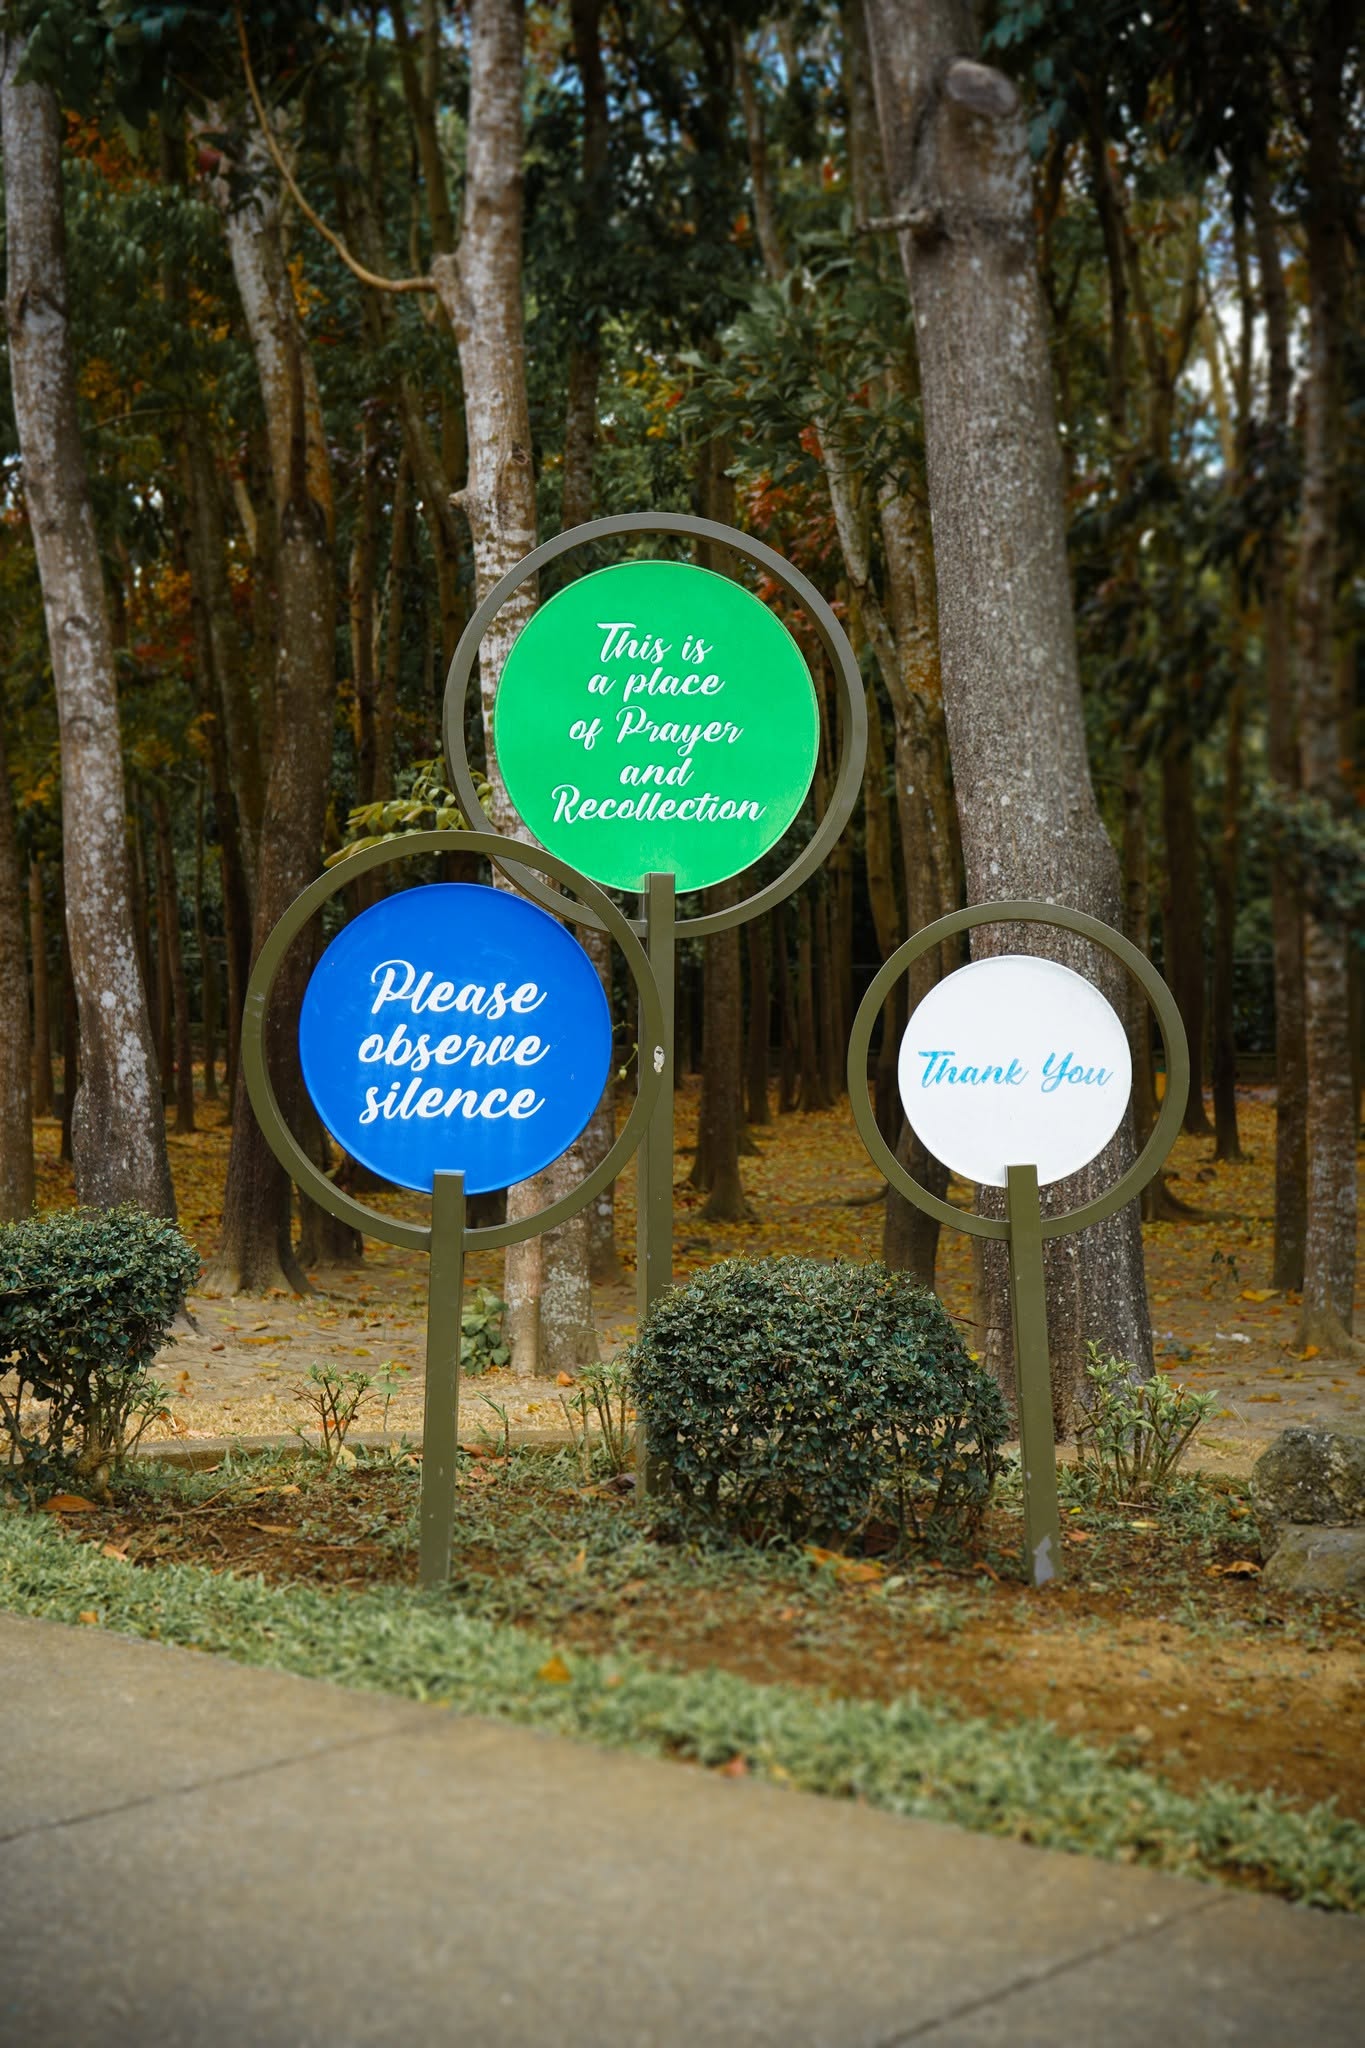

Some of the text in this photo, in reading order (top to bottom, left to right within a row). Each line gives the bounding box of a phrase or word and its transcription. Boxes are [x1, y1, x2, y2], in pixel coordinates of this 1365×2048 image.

[597, 622, 713, 664] This is
[587, 666, 725, 703] a place
[569, 705, 744, 757] of Prayer
[619, 757, 695, 787] and
[551, 784, 767, 824] Recollection
[370, 959, 548, 1020] Please
[358, 1023, 551, 1072] observe
[918, 1050, 1114, 1093] Thank You
[358, 1076, 546, 1124] silence
